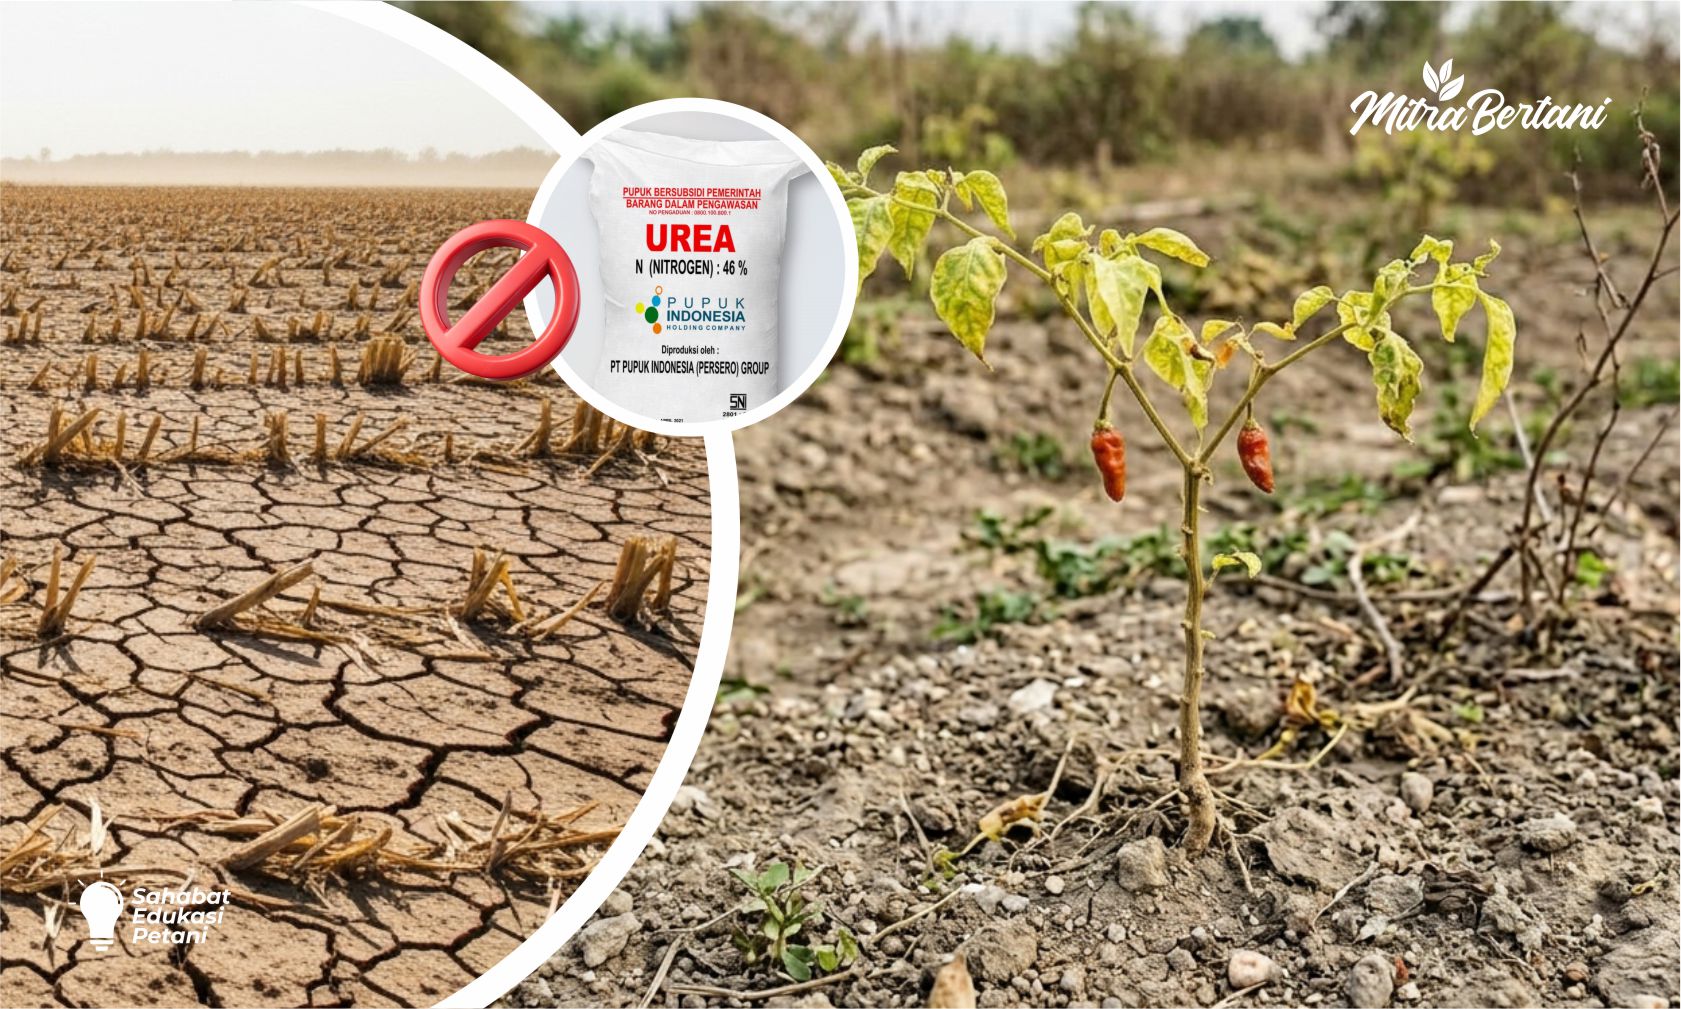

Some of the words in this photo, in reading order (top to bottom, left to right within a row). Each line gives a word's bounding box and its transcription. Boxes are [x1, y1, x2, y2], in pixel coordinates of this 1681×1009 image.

[623, 187, 652, 197] PUPUK
[654, 187, 705, 197] BERSUBSIDI
[707, 188, 761, 198] PEMERINTAH
[626, 199, 662, 209] BARANG
[665, 200, 695, 209] DALAM
[697, 200, 758, 209] PENGAWASAN
[646, 223, 736, 252] UREA
[635, 259, 643, 274] N
[649, 259, 714, 278] (NITROGEN)
[722, 259, 735, 275] 46
[738, 259, 748, 276] %
[667, 297, 745, 309] PUPUK
[666, 310, 746, 322] INDONESIA
[661, 345, 699, 356] Diproduksi
[700, 345, 715, 355] oleh
[610, 360, 621, 373] PT
[622, 360, 650, 374] PUPUK
[651, 360, 695, 374] INDONESIA
[696, 361, 739, 377] (PERSERO)
[740, 361, 770, 375] GROUP
